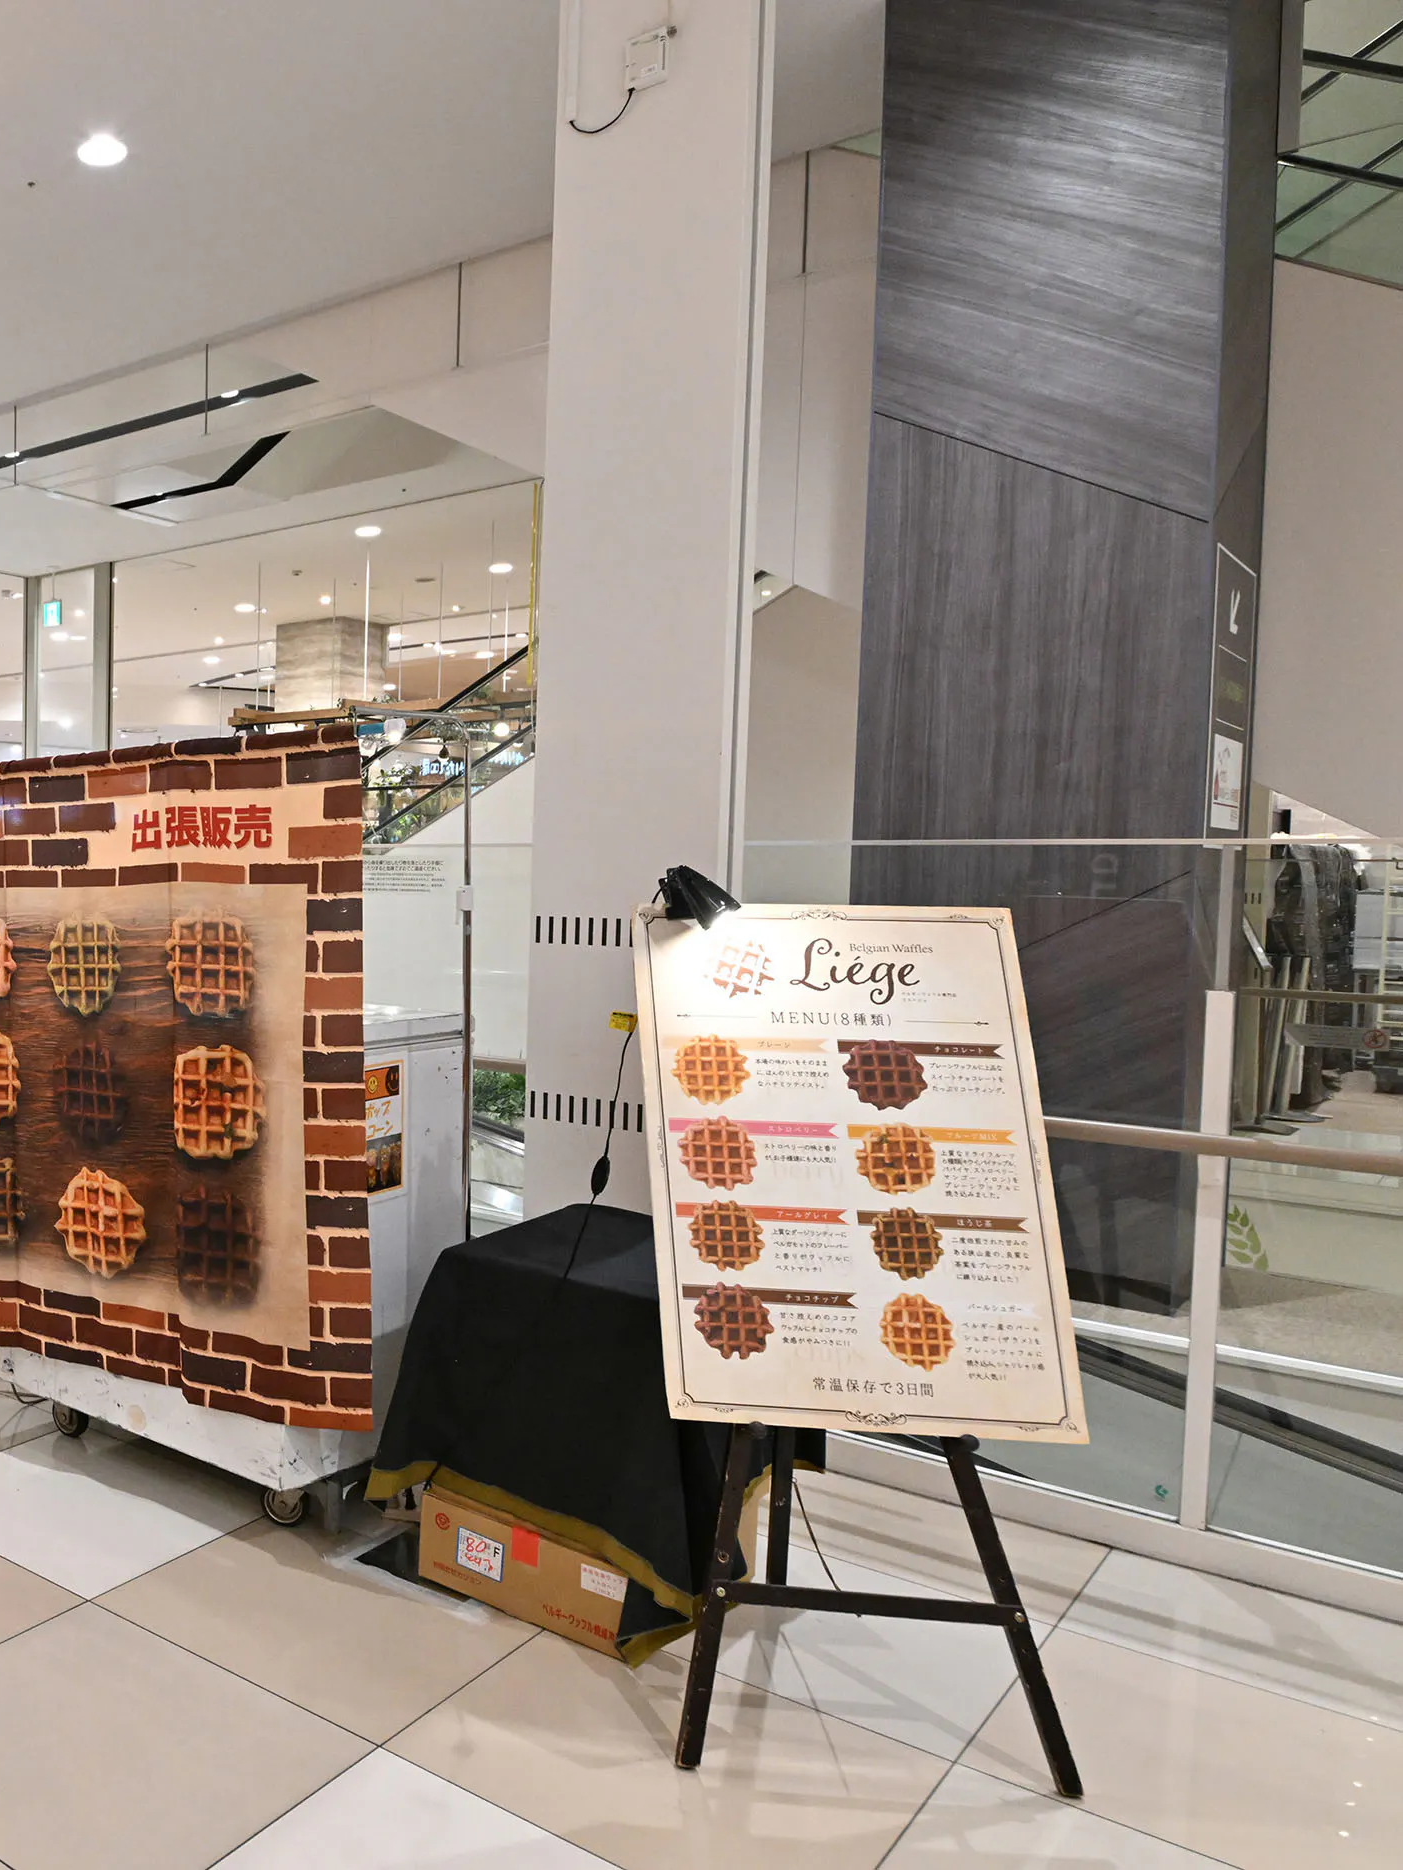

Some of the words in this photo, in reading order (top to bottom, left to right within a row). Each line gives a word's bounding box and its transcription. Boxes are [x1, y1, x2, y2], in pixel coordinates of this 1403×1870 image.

[131, 804, 273, 852] 出張販売
[849, 943, 890, 954] Belgian
[892, 943, 934, 954] Waffles
[790, 937, 920, 1005] Liége
[934, 1046, 984, 1055] チョコレート
[367, 1121, 394, 1140] コーン
[768, 1125, 819, 1134] ストロベリー
[776, 1210, 829, 1221] アールグレイ
[956, 1217, 993, 1228] ほうじ茶
[785, 1293, 839, 1304] チョコチップ
[812, 1376, 935, 1398] 常温保存で3日間
[465, 1536, 487, 1553] 80
